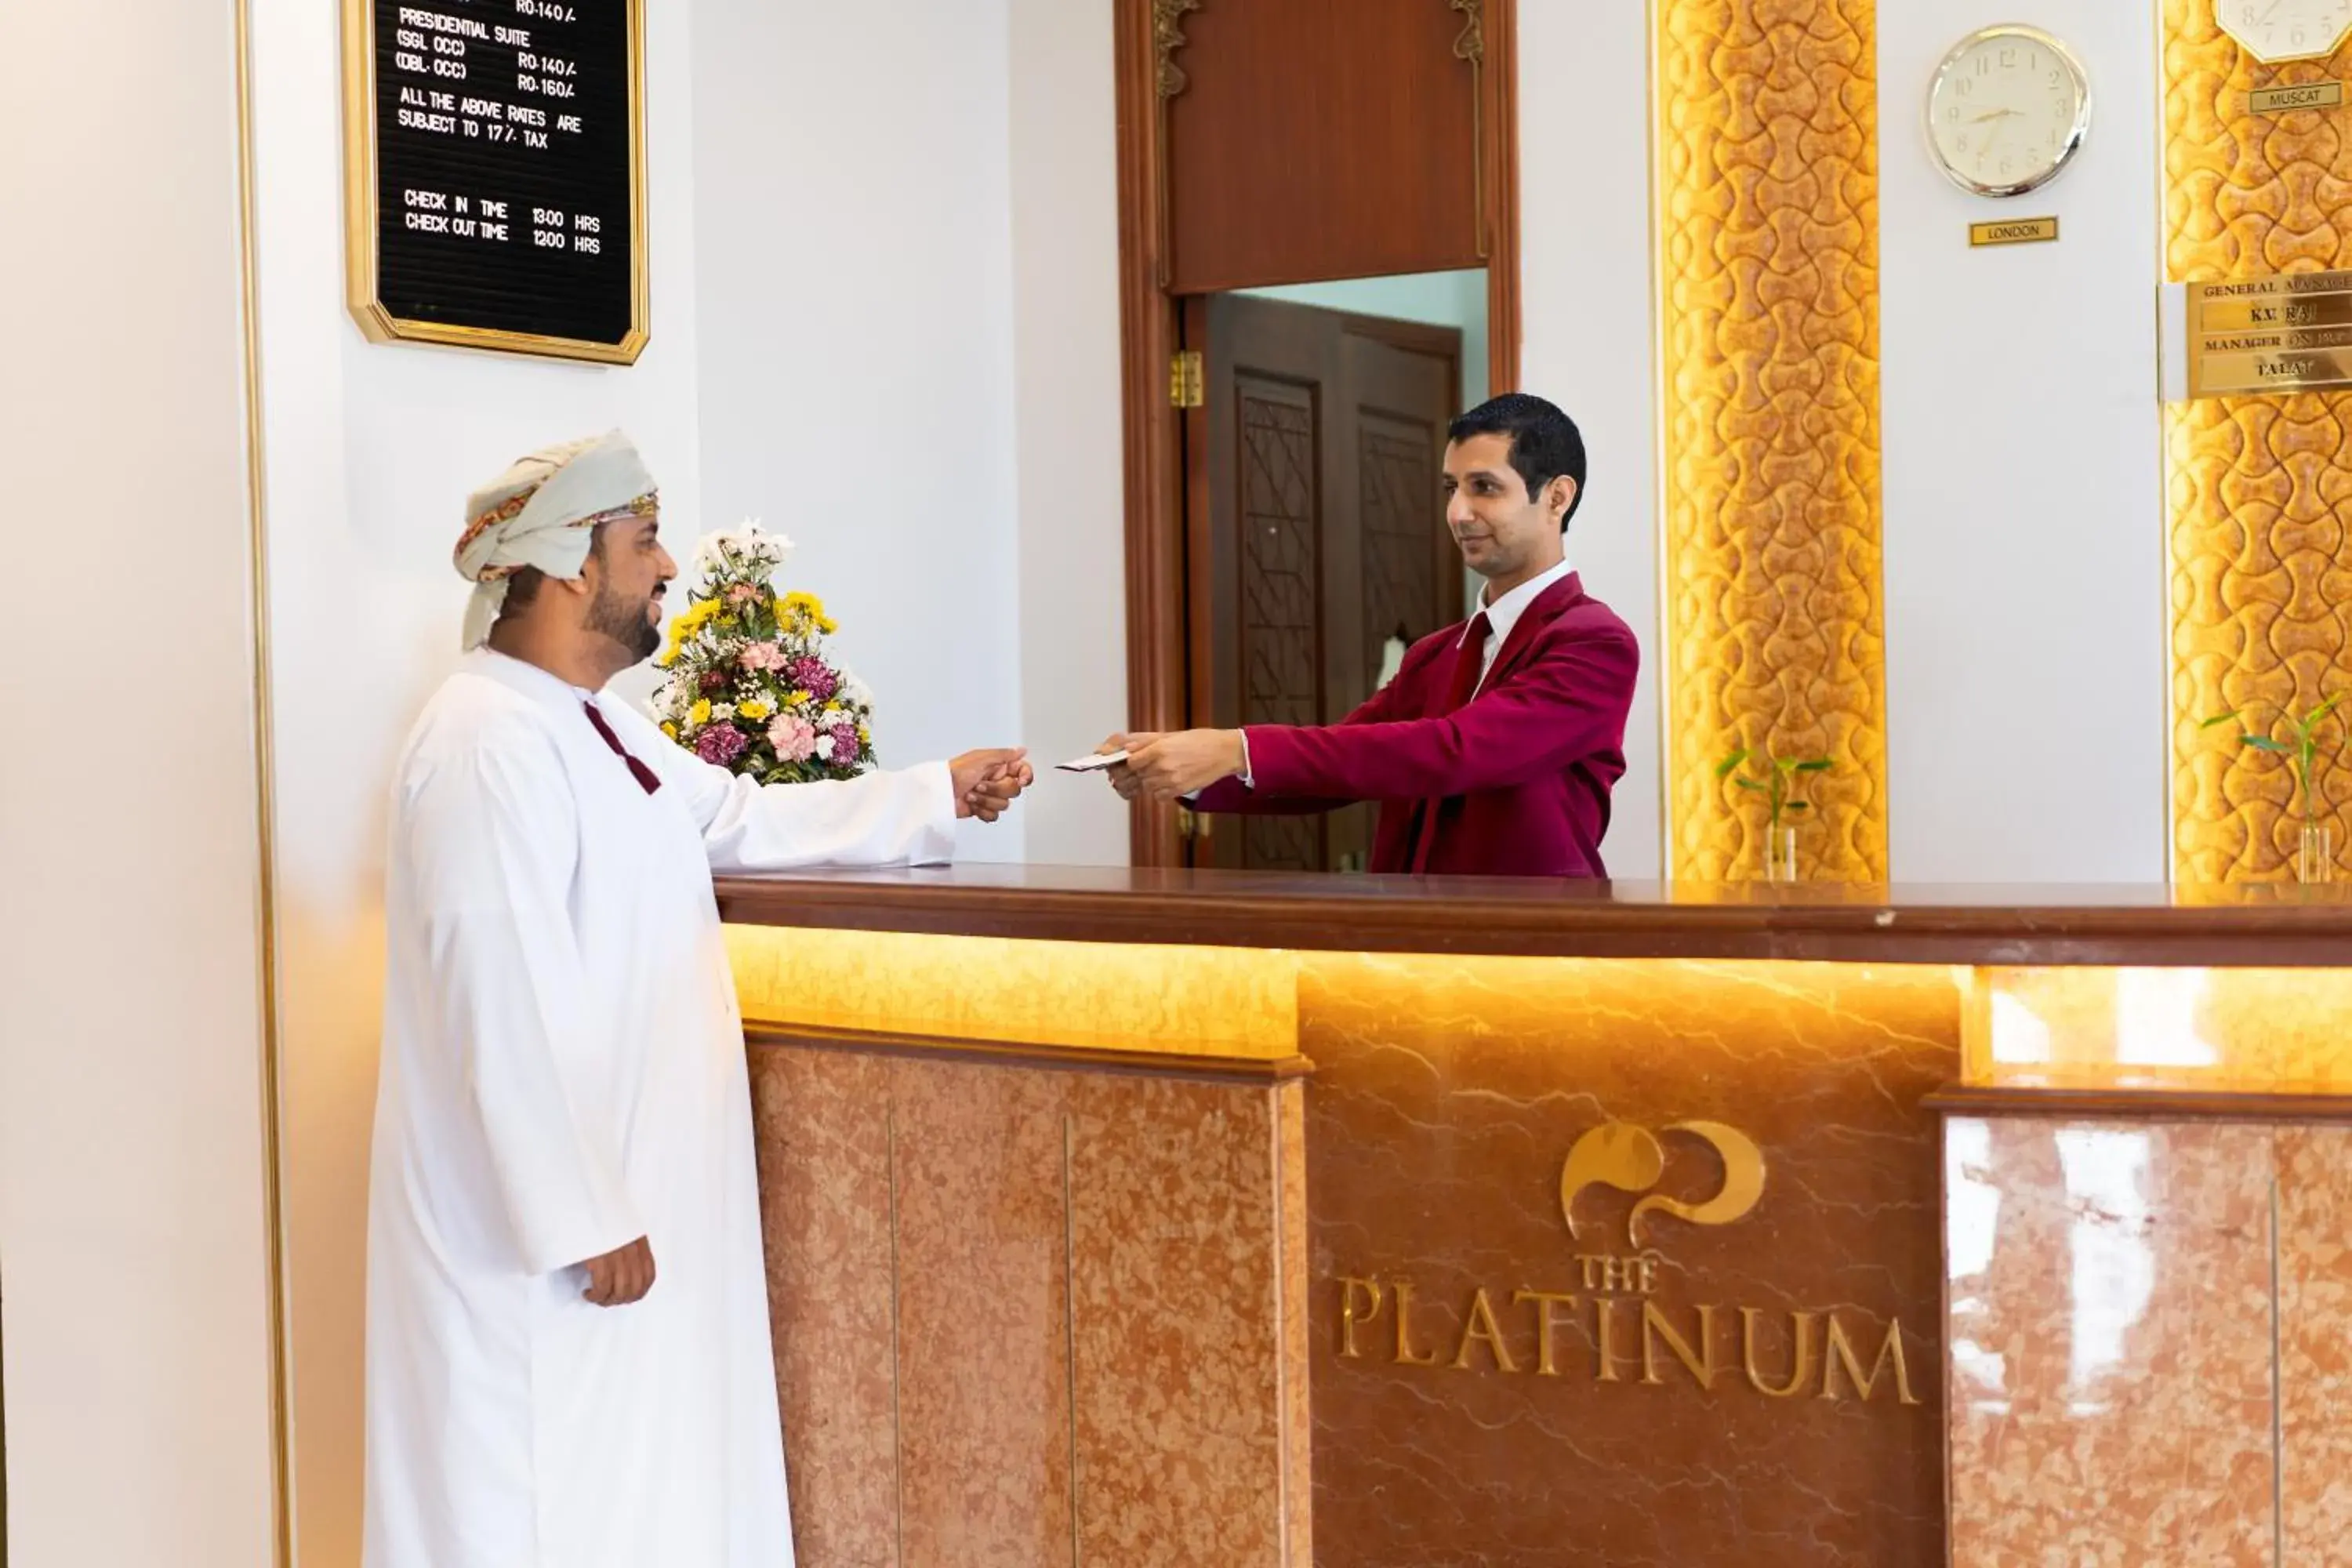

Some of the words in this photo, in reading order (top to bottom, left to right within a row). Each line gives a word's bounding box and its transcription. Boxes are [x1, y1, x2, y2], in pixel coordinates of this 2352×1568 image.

[397, 29, 428, 50] (SGL
[434, 36, 465, 56] OCC)
[399, 7, 490, 39] PRESIDENTIAL
[494, 26, 531, 47] SUITE
[434, 59, 466, 79] OCC)
[401, 87, 426, 107] ALL
[430, 91, 455, 111] THE
[461, 97, 502, 119] ABOVE
[508, 105, 546, 127] RATES
[557, 115, 582, 133] ARE
[2270, 90, 2321, 106] MUSCAT
[398, 109, 456, 134] SUBJECT
[463, 119, 479, 137] TO
[523, 130, 548, 149] TAX
[405, 189, 447, 210] CHECK
[456, 196, 468, 213] IN
[480, 199, 508, 219] TIME
[575, 215, 600, 233] HRS
[405, 212, 448, 233] CHECK
[452, 218, 476, 238] OUT
[480, 222, 508, 241] TIME
[575, 237, 600, 254] HRS
[1988, 225, 2039, 238] LONDON
[2205, 282, 2277, 297] GENERAL
[2205, 336, 2281, 351] MANAGER
[1573, 1254, 1660, 1294] THE
[1337, 1276, 1922, 1404] PLATINUM
